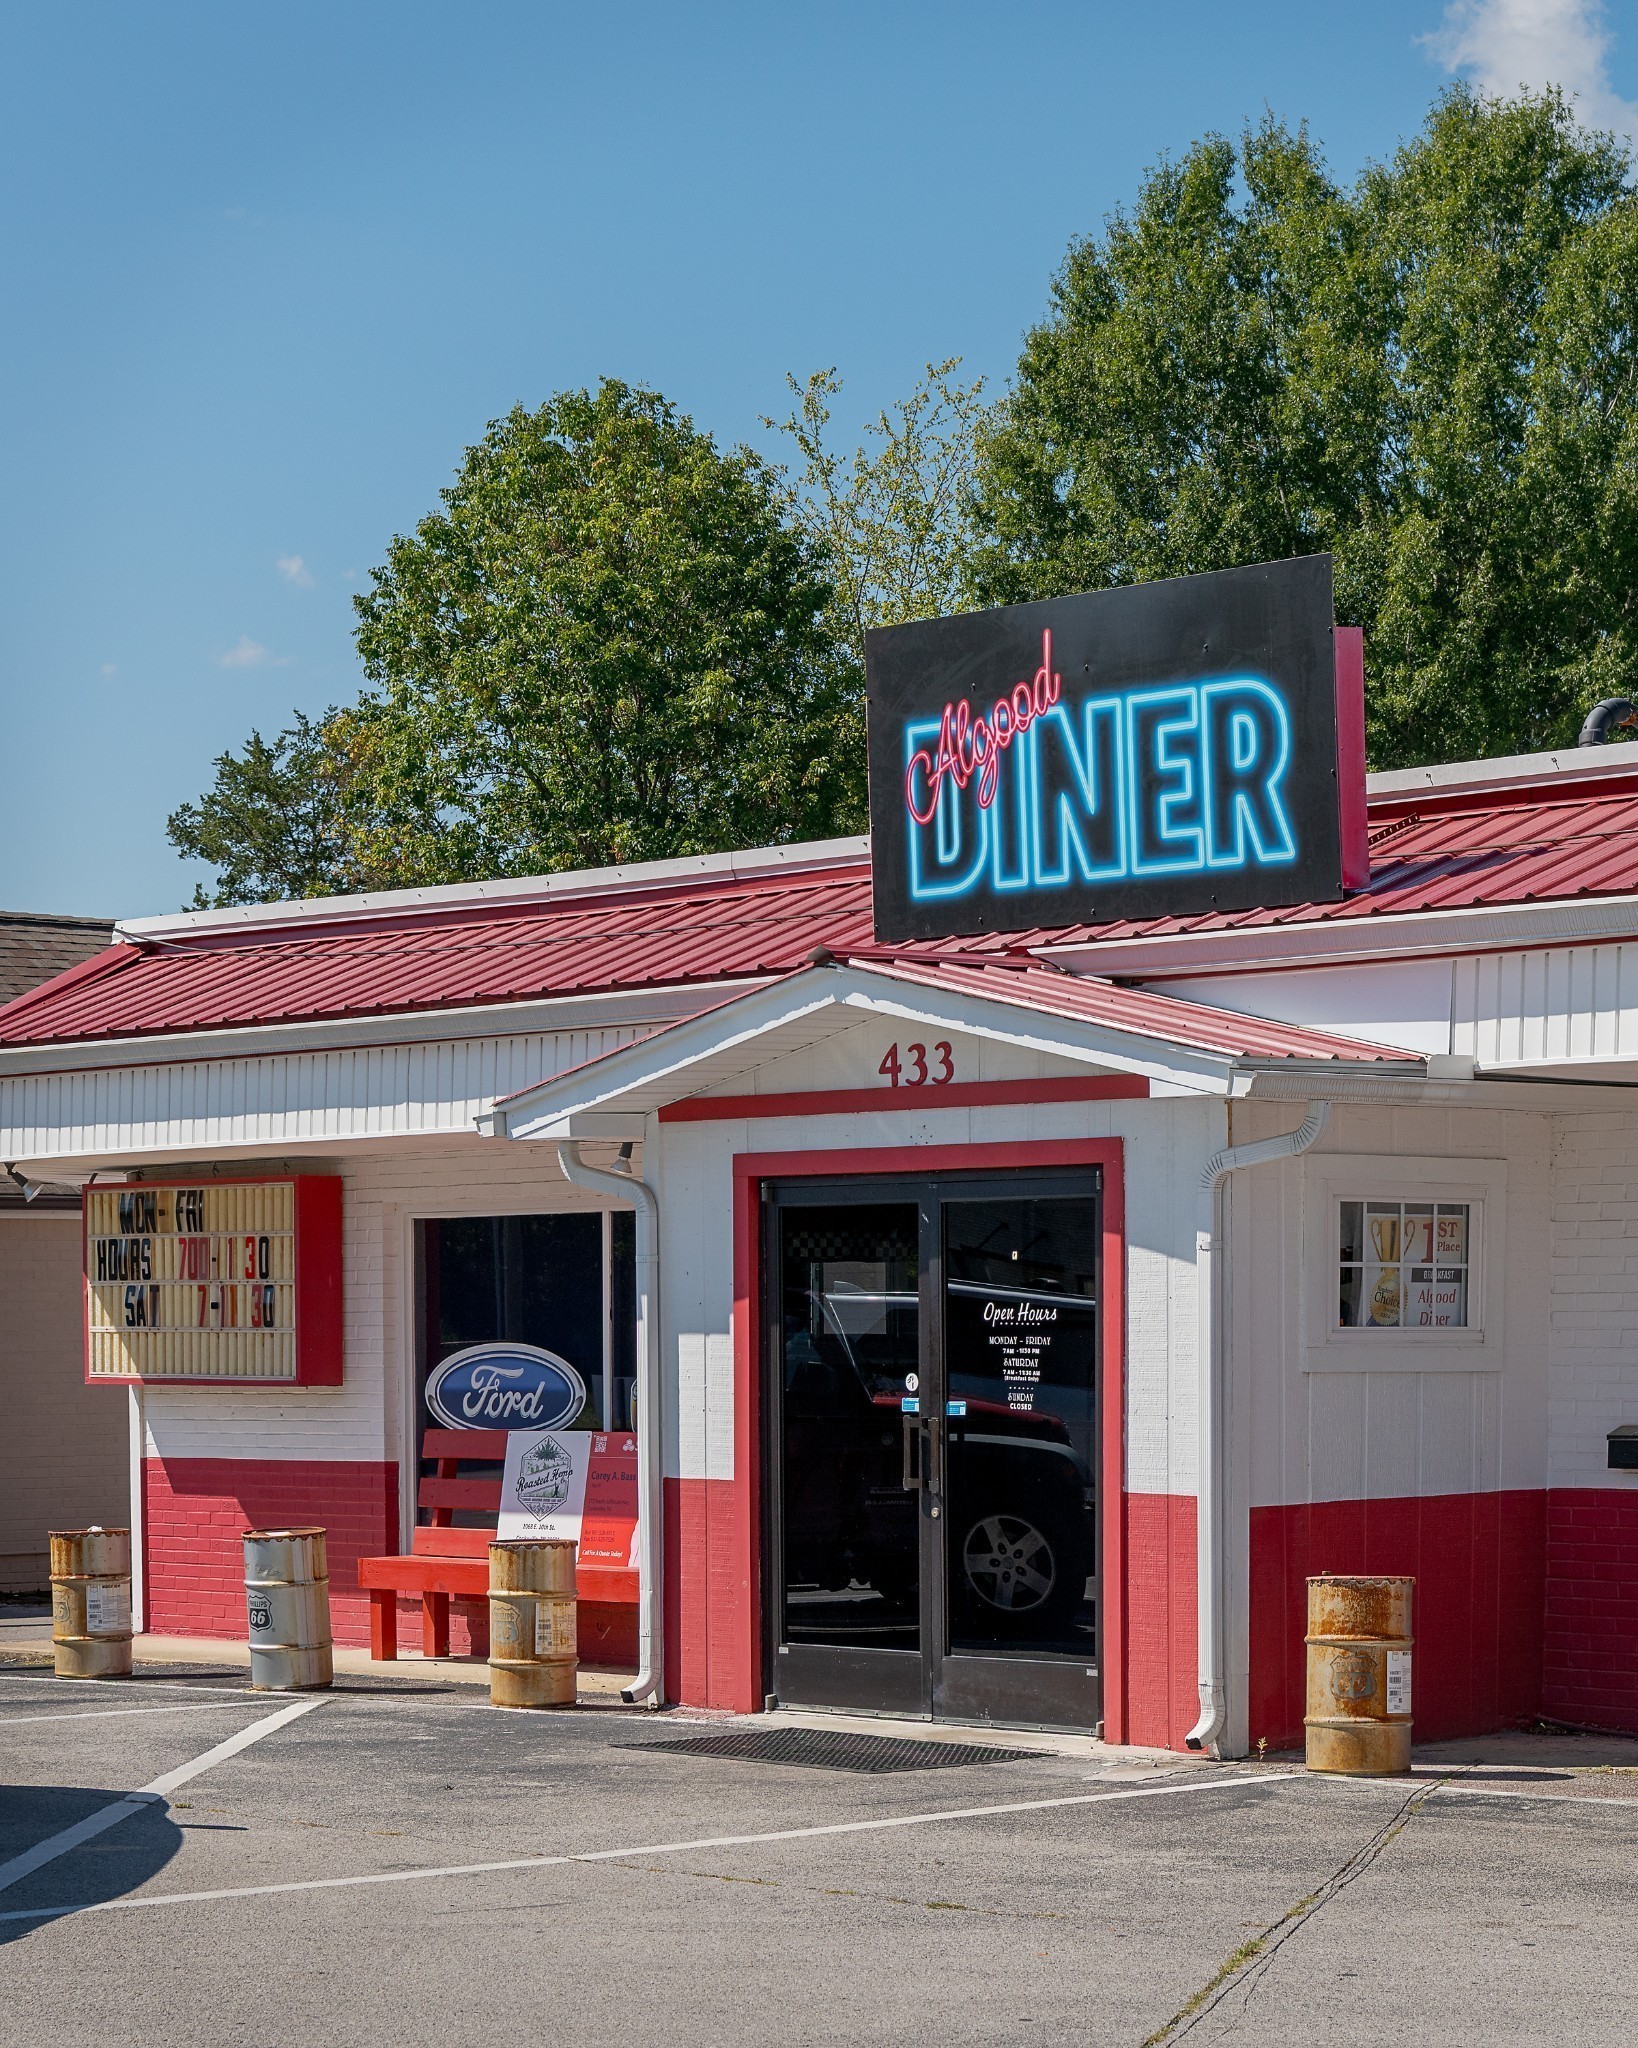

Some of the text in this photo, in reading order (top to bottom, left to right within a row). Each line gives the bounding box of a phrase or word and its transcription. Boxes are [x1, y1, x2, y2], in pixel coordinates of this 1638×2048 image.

[906, 628, 1061, 825] Algood
[907, 679, 1296, 898] DINER
[878, 1041, 955, 1088] 433
[119, 1191, 157, 1234] MON
[176, 1189, 204, 1232] FRI
[1436, 1241, 1461, 1252] Place
[97, 1238, 152, 1281] HOURS
[1423, 1270, 1455, 1280] BRKFAST
[124, 1284, 160, 1328] SAT
[1374, 1291, 1401, 1309] Choice
[983, 1301, 1057, 1328] Open Hours
[988, 1336, 1018, 1345] MONDAY
[1025, 1336, 1051, 1346] FRIDAY
[1003, 1357, 1039, 1368] SATURDAY
[462, 1365, 546, 1420] Ford
[1007, 1392, 1034, 1402] SUNDAY
[1009, 1402, 1032, 1411] CLOSED
[516, 1467, 573, 1492] Roasted Hemp
[591, 1470, 637, 1482] Carey A. Bass
[250, 1610, 266, 1625] 66
